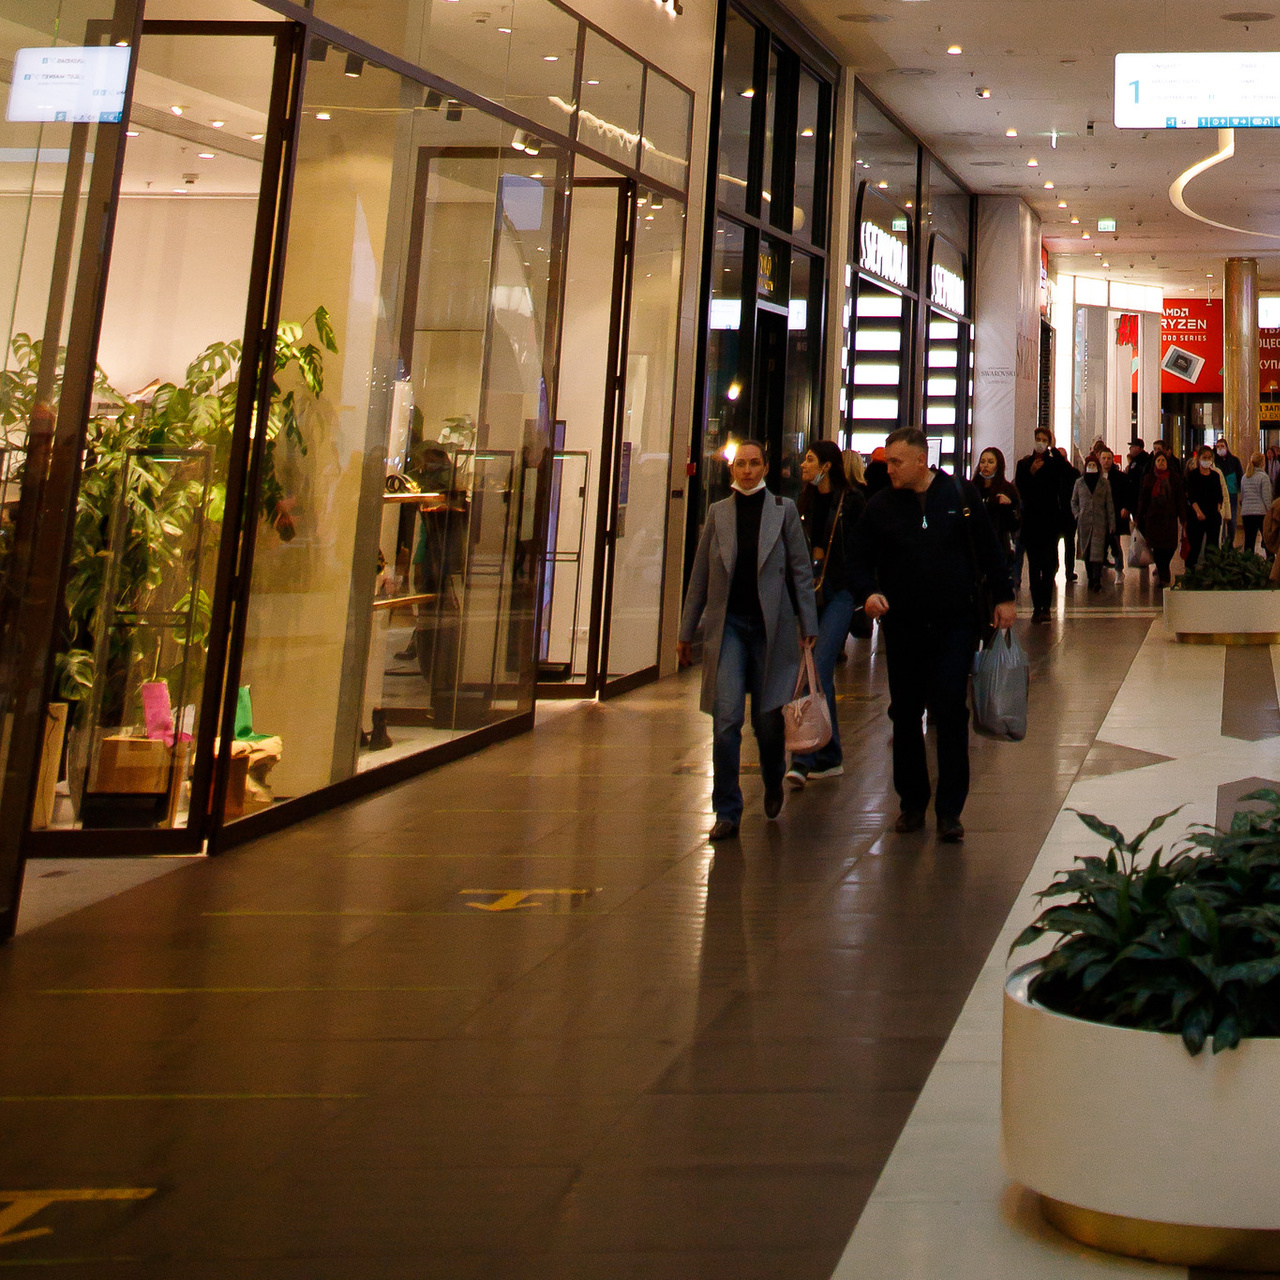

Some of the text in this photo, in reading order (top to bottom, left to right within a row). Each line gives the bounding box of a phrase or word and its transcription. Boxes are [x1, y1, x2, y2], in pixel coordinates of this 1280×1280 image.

[1128, 80, 1139, 104] 1
[1161, 319, 1207, 329] RYZEN
[1179, 334, 1207, 342] SERIES
